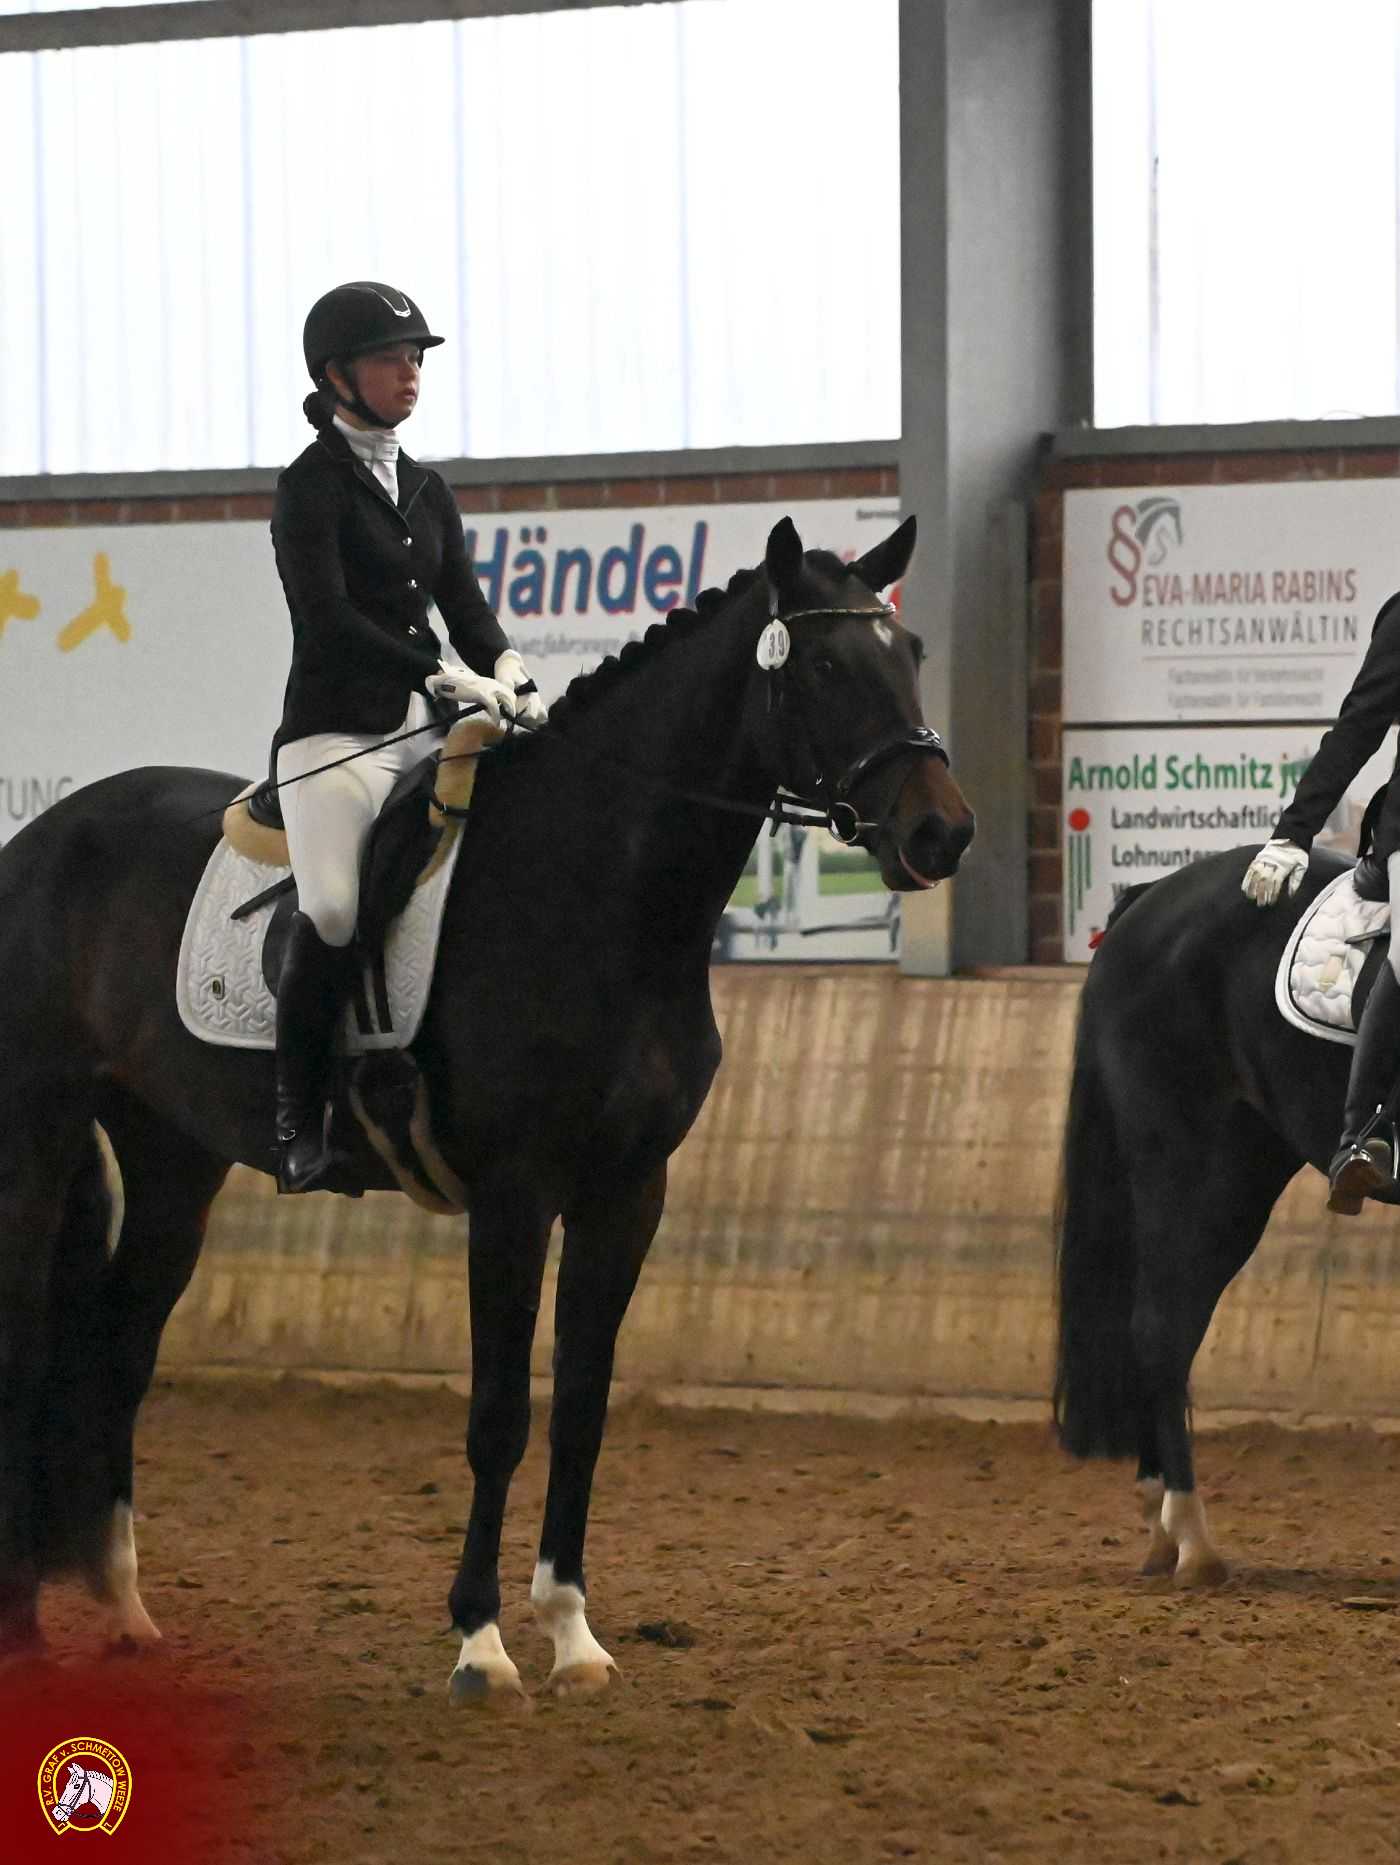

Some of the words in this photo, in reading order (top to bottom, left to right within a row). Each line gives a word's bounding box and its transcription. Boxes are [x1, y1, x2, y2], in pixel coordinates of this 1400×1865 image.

[464, 519, 708, 617] Händel
[1142, 571, 1267, 606] EVA-MARIA
[1272, 568, 1358, 603] RABINS
[1141, 610, 1358, 647] RECHTSANWÄLTIN
[1069, 754, 1158, 790] Arnold
[1165, 752, 1275, 790] Schmitz
